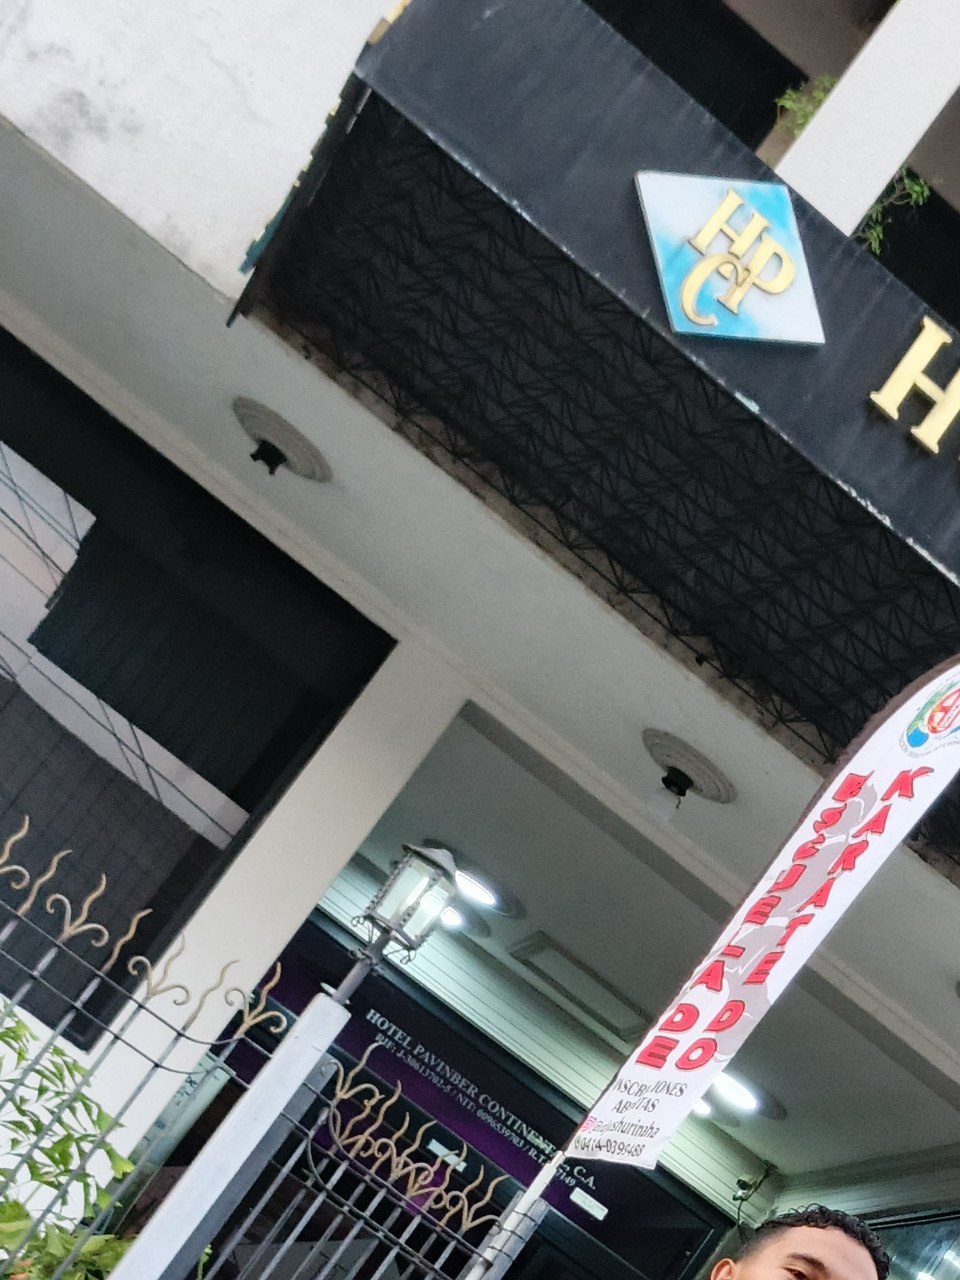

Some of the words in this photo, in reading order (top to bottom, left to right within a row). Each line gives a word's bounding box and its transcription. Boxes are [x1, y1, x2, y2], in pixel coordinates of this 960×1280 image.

[743, 766, 934, 985] KARATE
[635, 1003, 700, 1070] DE
[675, 1000, 745, 1070] DO
[366, 1008, 412, 1049] HOTEL
[413, 1043, 479, 1098] PAVINBER
[573, 1165, 597, 1189] C.A.
